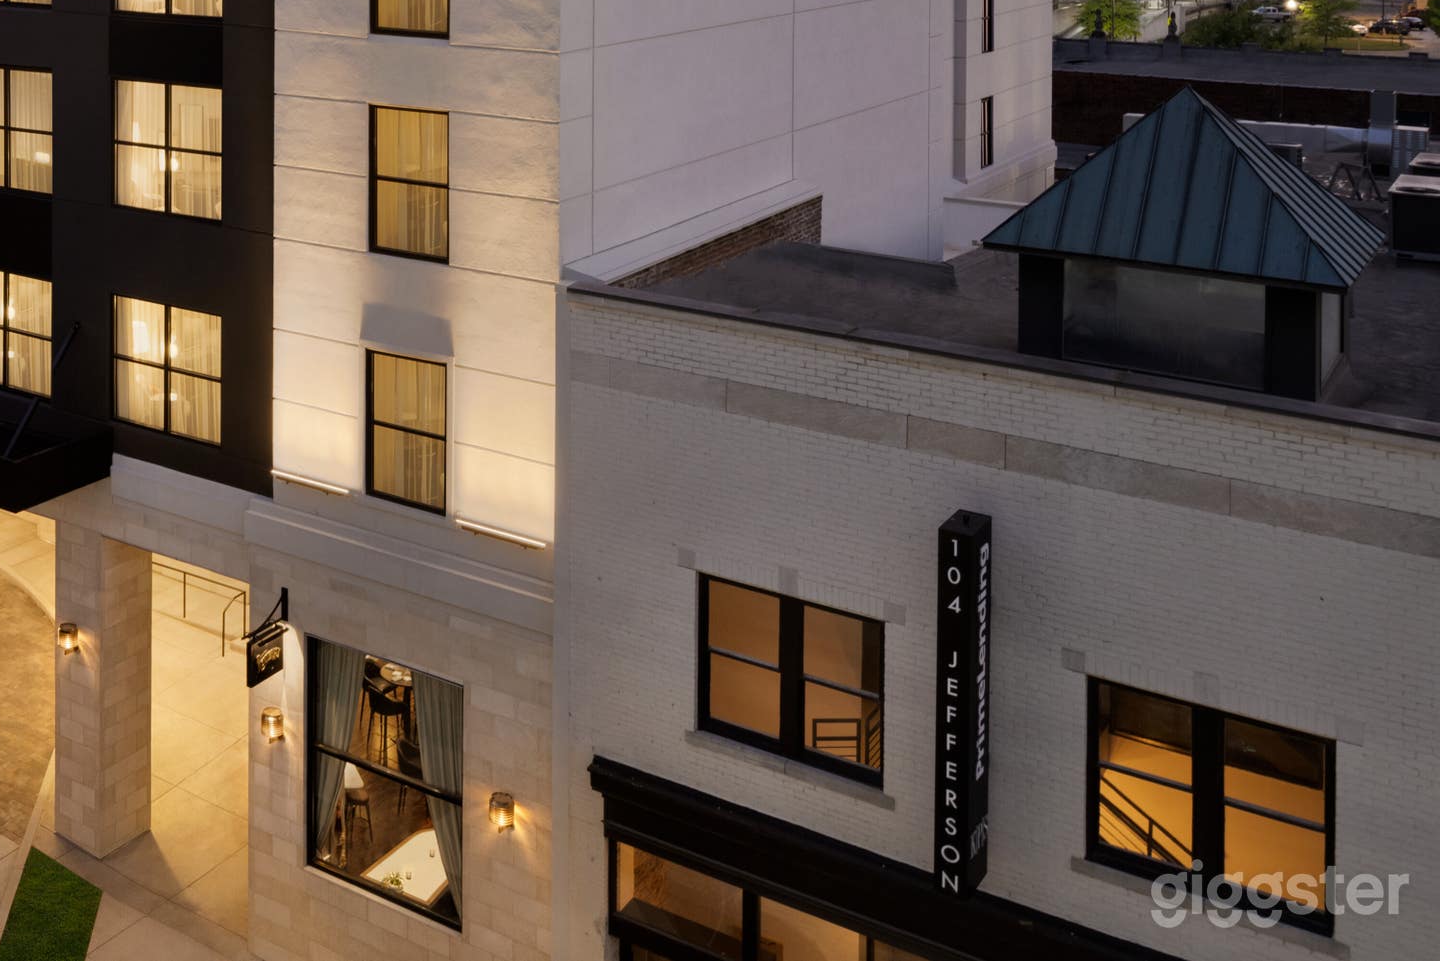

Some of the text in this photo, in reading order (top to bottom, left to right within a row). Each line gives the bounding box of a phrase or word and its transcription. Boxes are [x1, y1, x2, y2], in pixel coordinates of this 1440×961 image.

[941, 539, 961, 893] 104 JEFFERSON
[976, 542, 989, 781] PrimeLending
